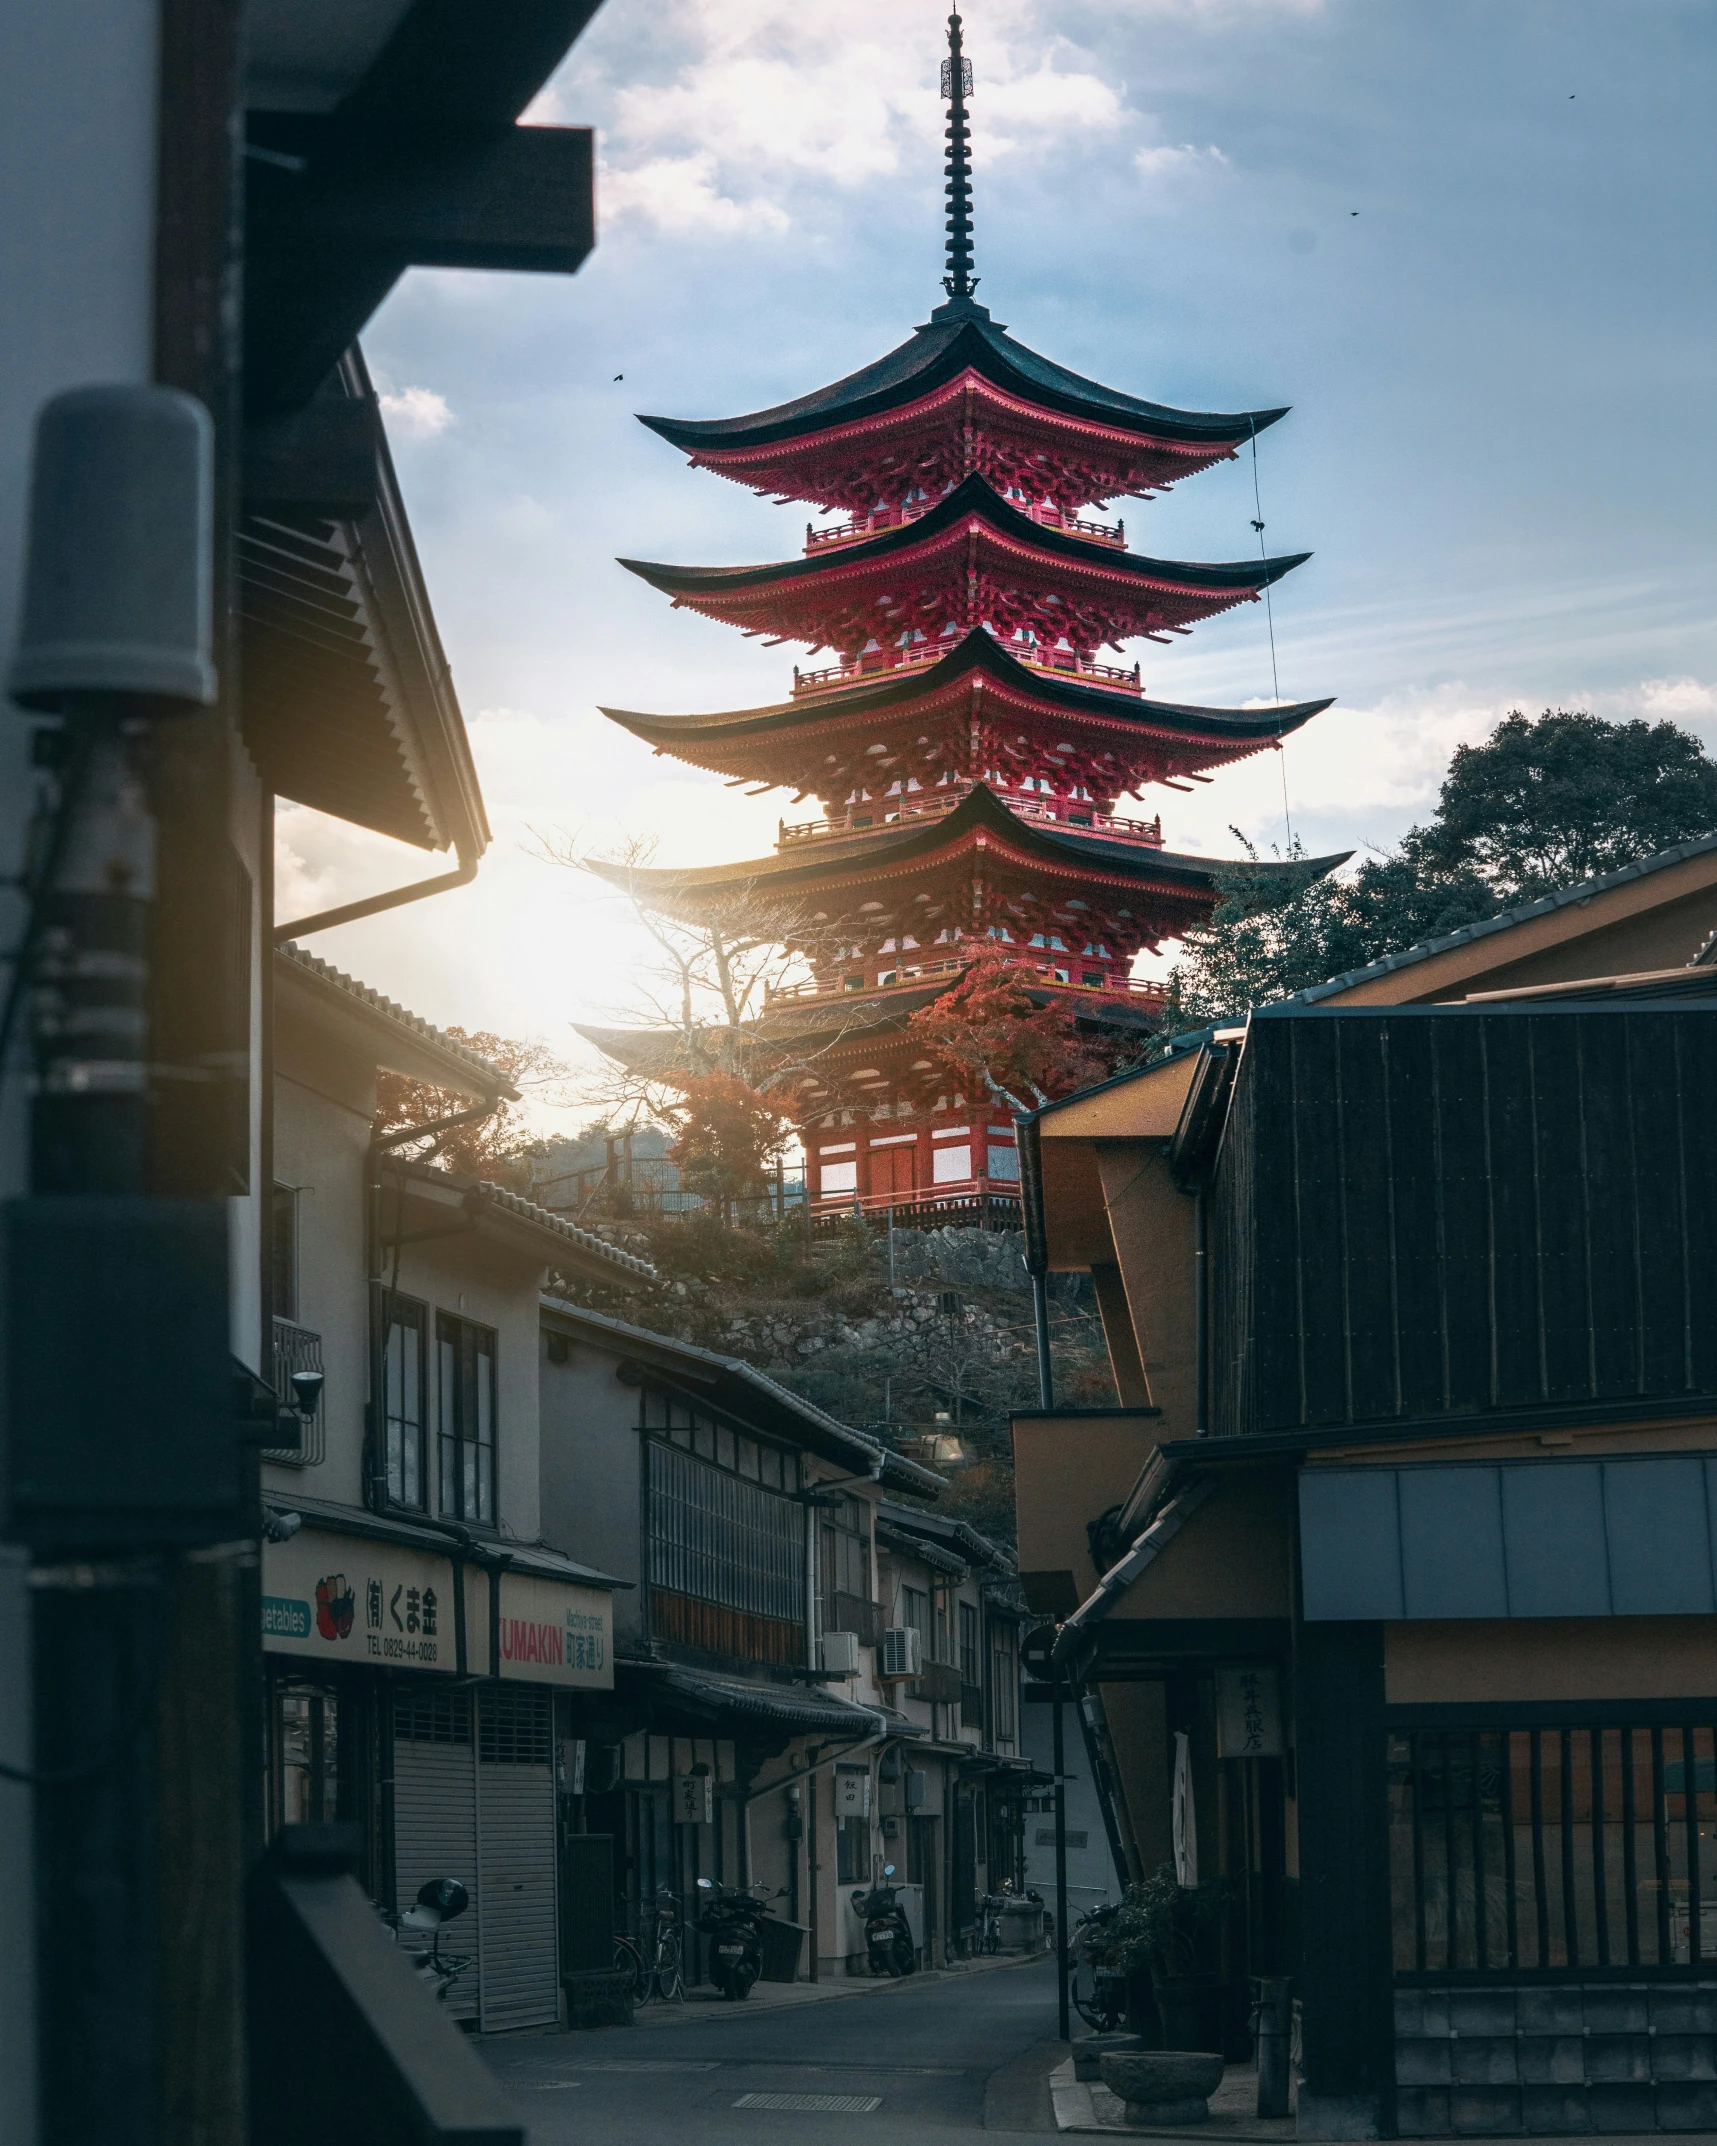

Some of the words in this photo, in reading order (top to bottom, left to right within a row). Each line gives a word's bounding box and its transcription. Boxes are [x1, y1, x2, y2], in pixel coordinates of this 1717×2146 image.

[366, 1635, 381, 1656] TEL
[384, 1638, 437, 1661] 0829-44-0028
[566, 1632, 603, 1671] 町家通り
[683, 1780, 698, 1819] 町家通り
[844, 1780, 857, 1801] 飯田
